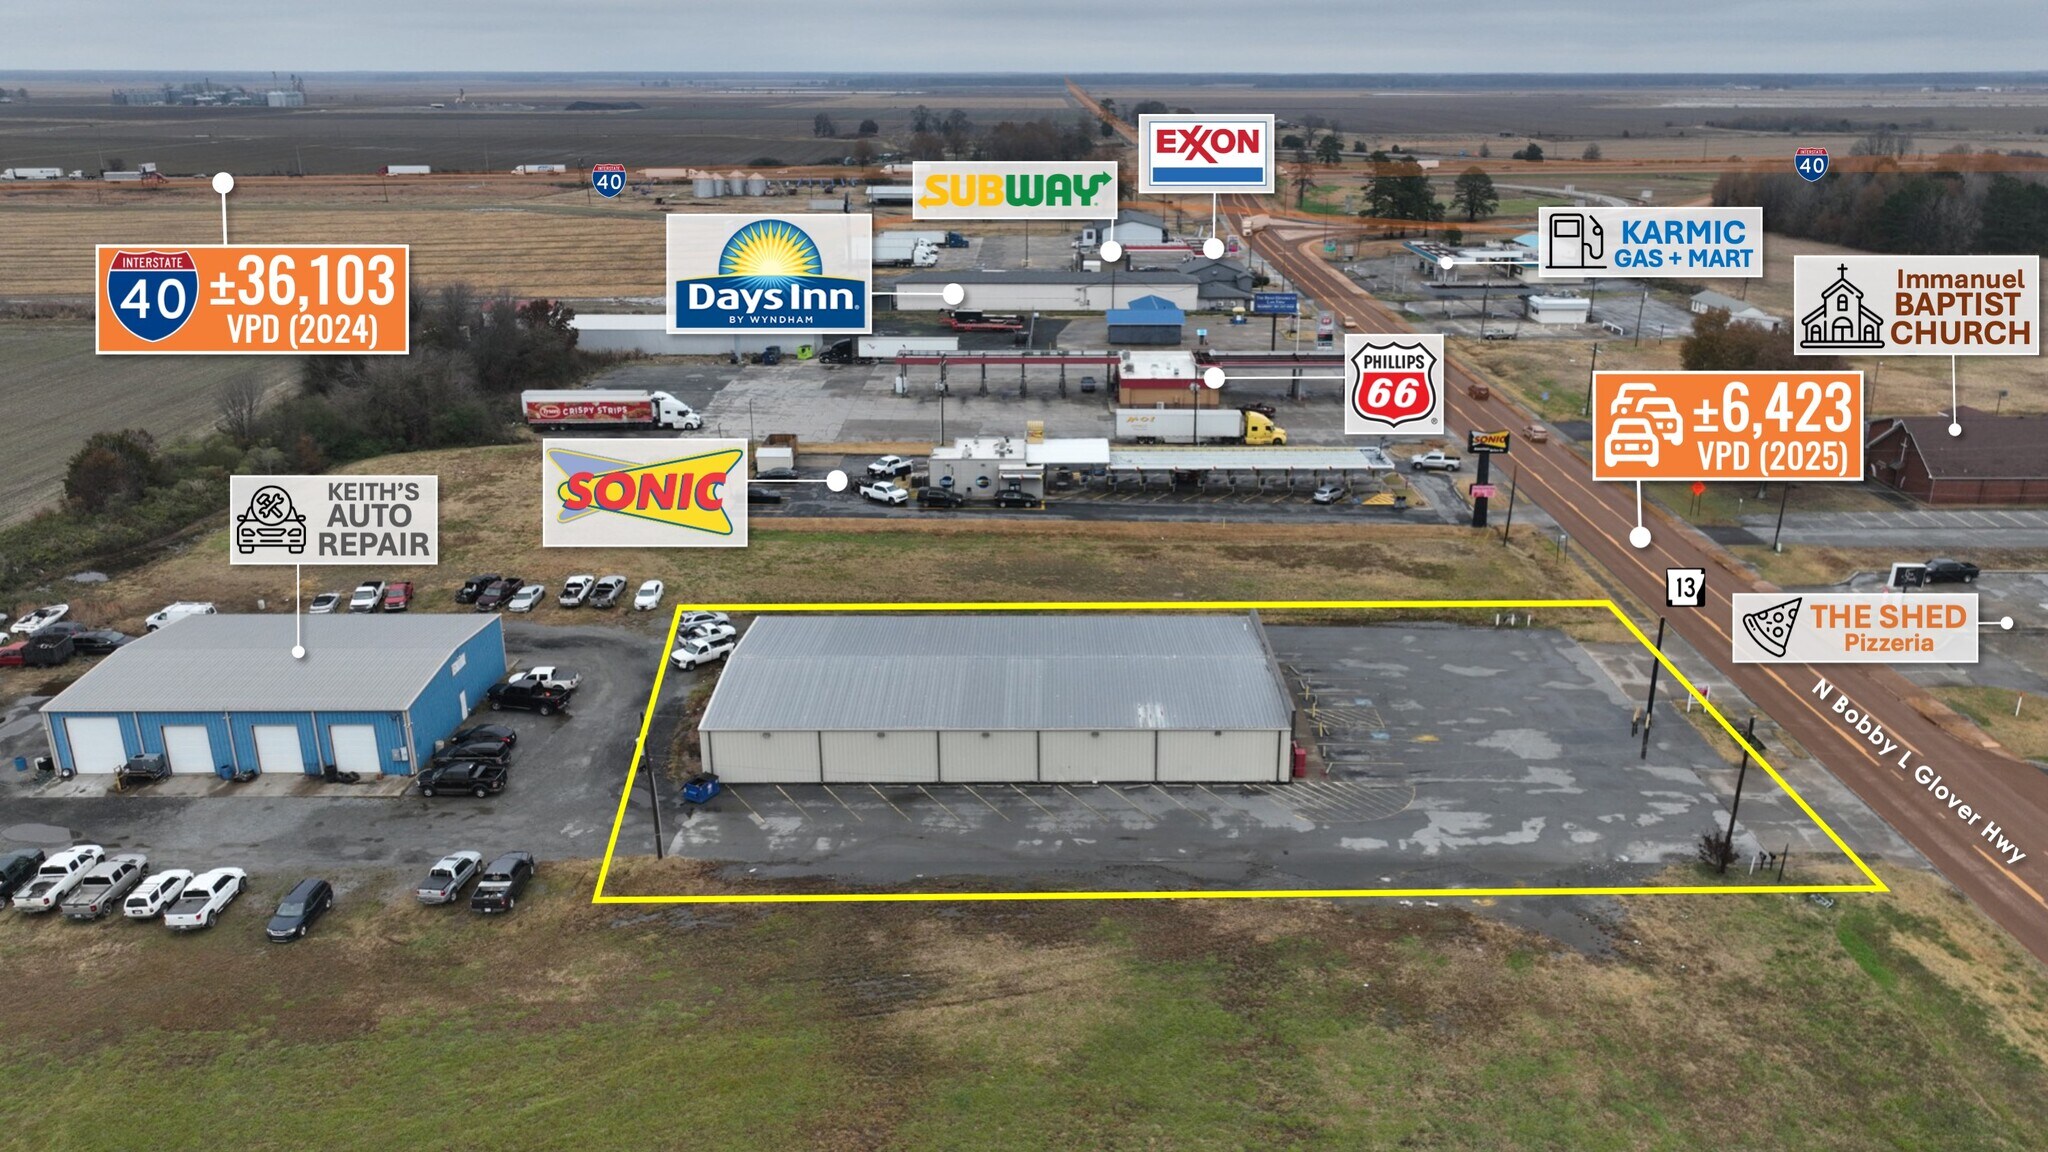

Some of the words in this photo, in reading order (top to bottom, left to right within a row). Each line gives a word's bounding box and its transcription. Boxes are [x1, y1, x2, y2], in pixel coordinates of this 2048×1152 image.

[562, 406, 594, 416] CRISPY
[597, 406, 628, 415] STRIPS
[1474, 435, 1506, 444] SONIC
